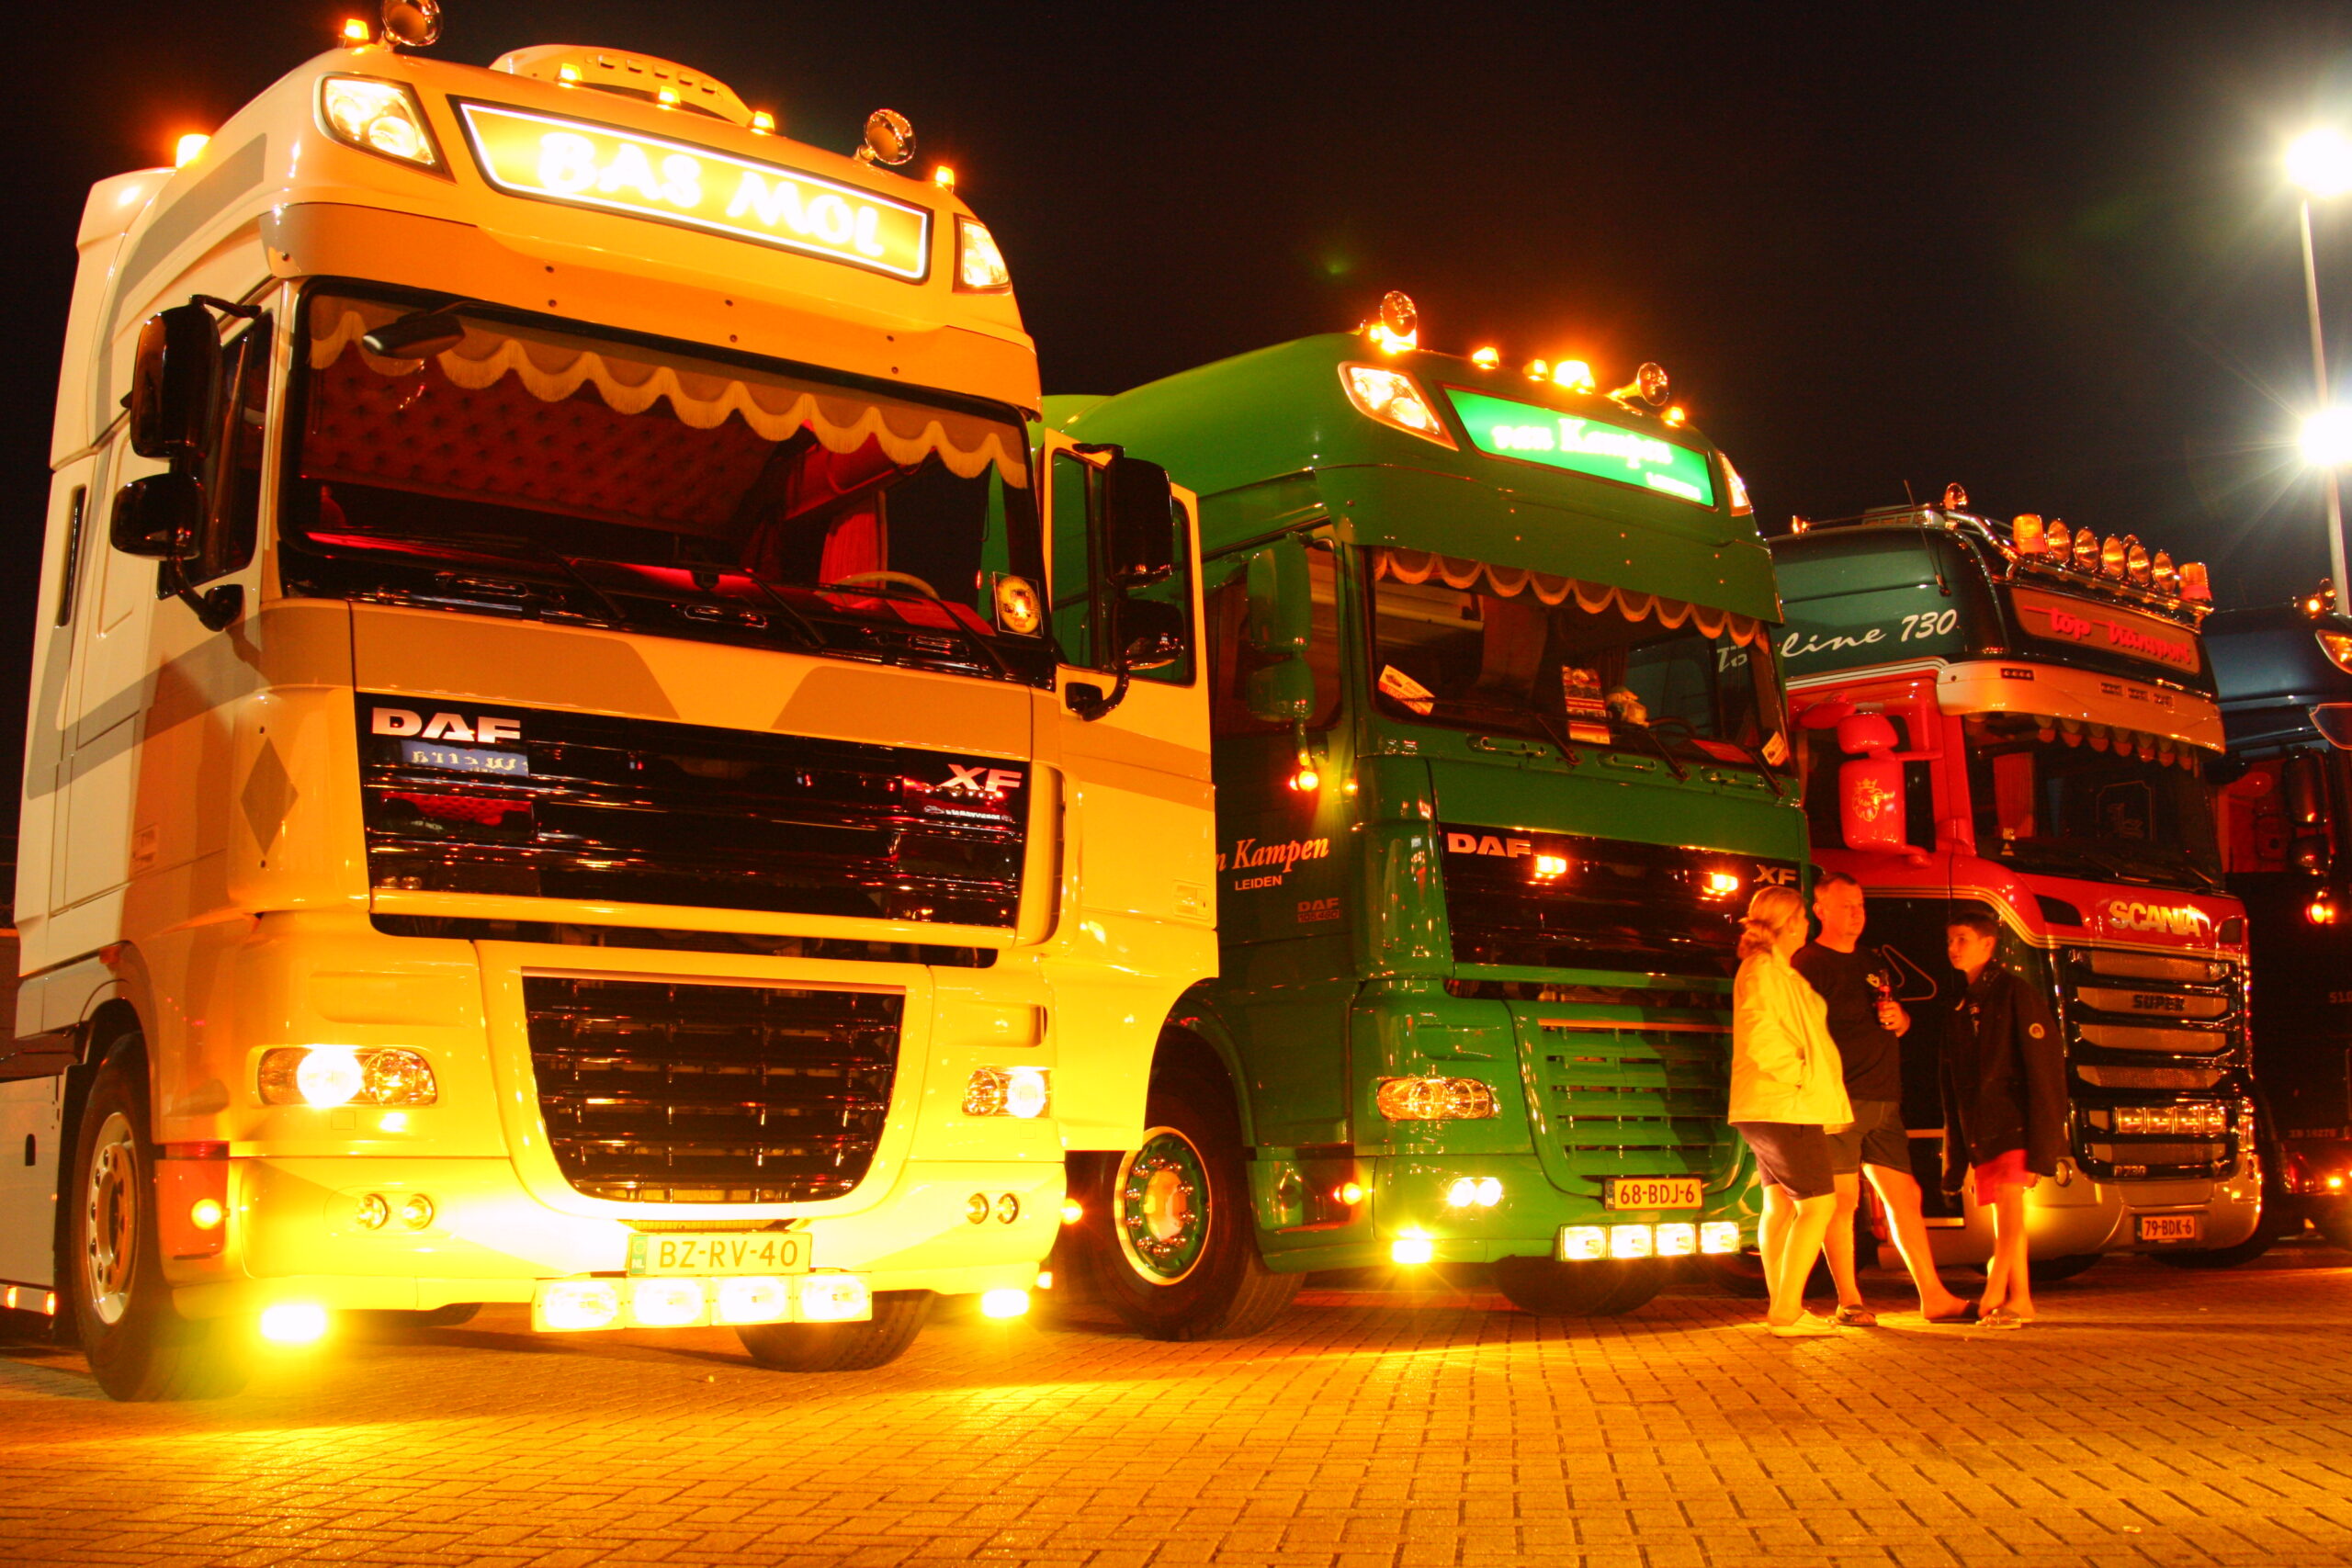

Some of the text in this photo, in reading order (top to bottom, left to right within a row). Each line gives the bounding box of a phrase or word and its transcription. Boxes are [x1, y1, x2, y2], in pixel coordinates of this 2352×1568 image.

[537, 132, 884, 256] BAS MOL
[1900, 608, 1958, 642] 730
[371, 706, 521, 744] DAF
[940, 763, 1023, 792] XF
[1231, 838, 1329, 874] Kampen
[1447, 832, 1532, 858] DAF
[1234, 874, 1283, 891] LEIDEN
[1753, 863, 1796, 886] XF
[1297, 897, 1340, 912] DAF
[2108, 900, 2202, 938] SCANIA
[2132, 994, 2186, 1012] SUPER
[1620, 1183, 1695, 1205] 68-BDJ-6
[2144, 1219, 2192, 1236] 79-BDK-6
[659, 1239, 798, 1269] BZ-RV-40
